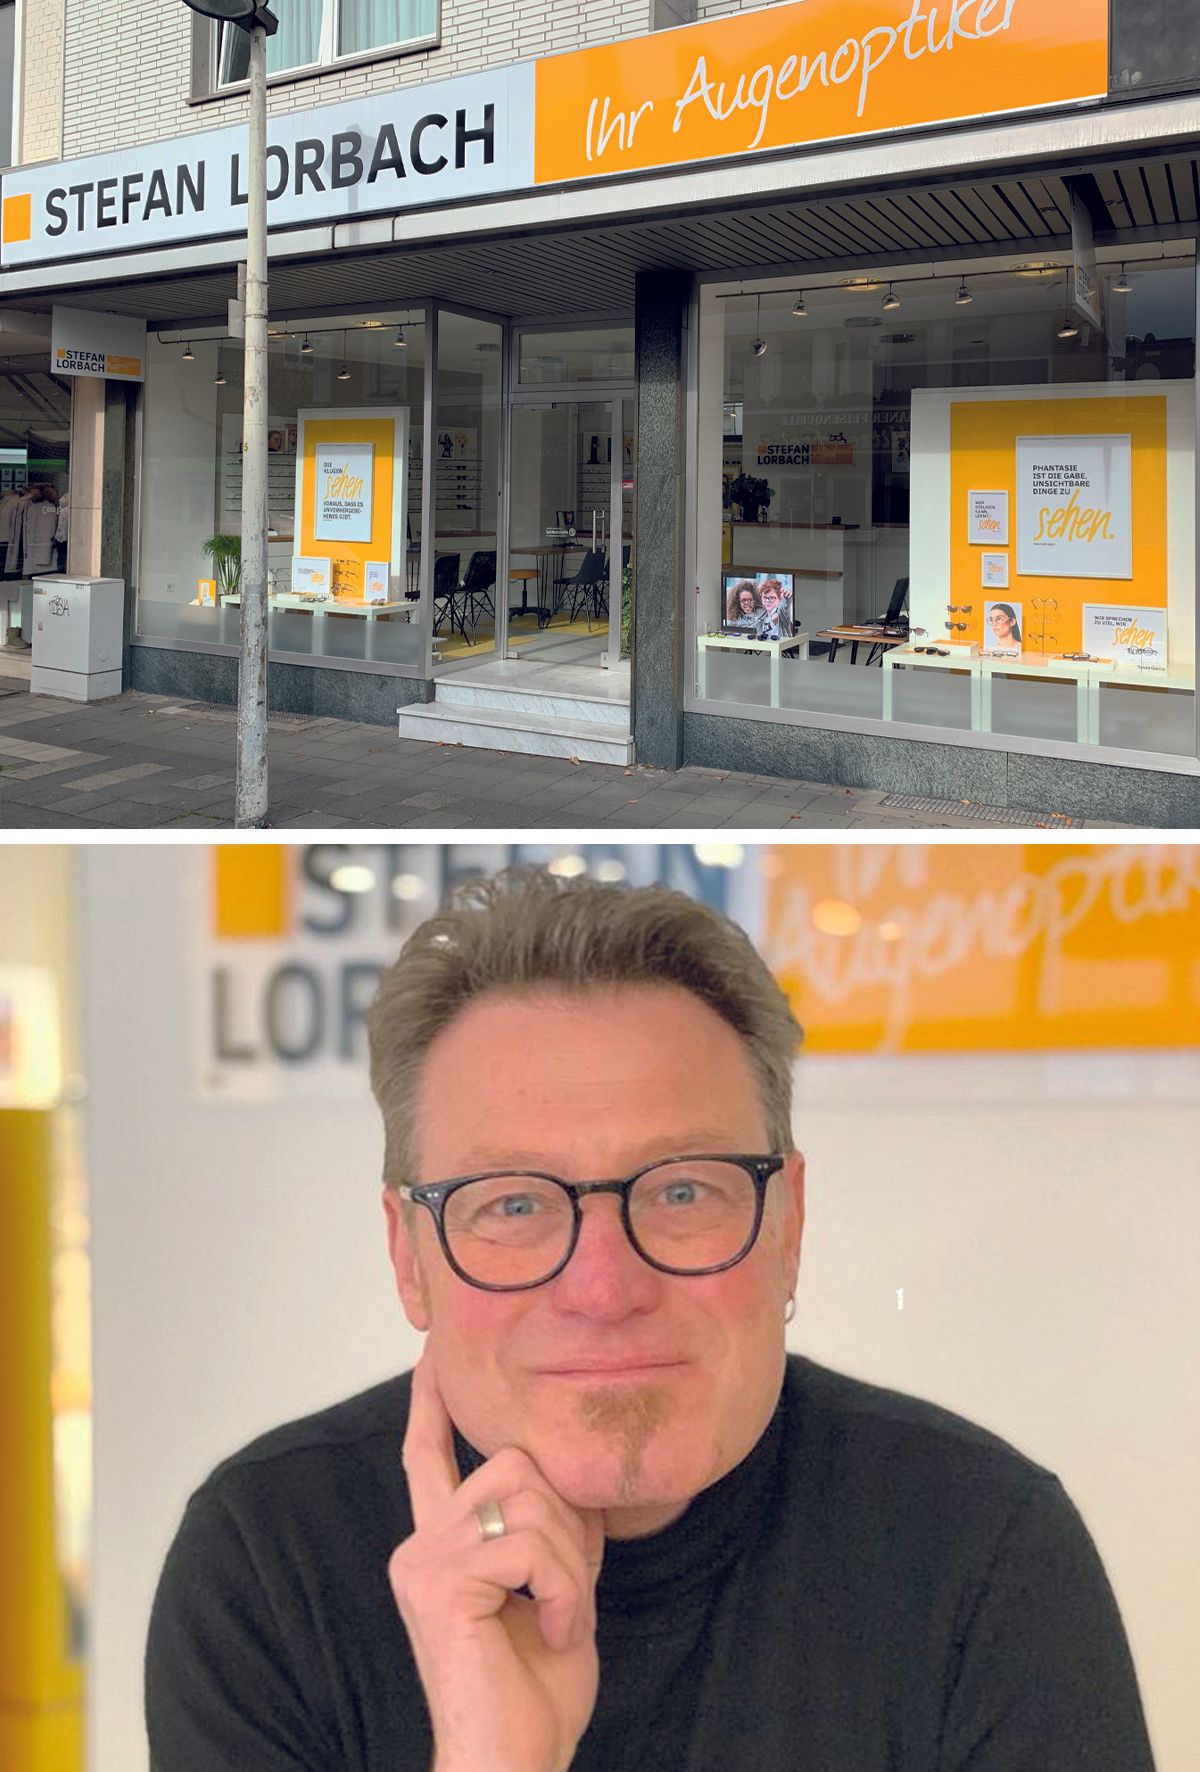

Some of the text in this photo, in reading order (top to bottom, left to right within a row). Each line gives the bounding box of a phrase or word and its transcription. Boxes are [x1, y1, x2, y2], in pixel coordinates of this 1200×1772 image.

[585, 97, 653, 161] Ihr
[44, 103, 495, 237] STEFAN LORBACH
[56, 359, 105, 372] LORBACH
[66, 350, 105, 362] STEFAN
[757, 455, 810, 465] LORBACH
[767, 444, 810, 455] STEFAN
[323, 463, 364, 500] sehen
[1063, 472, 1088, 480] GABE,
[1032, 487, 1115, 543] sehen.
[1112, 618, 1156, 648] sehen
